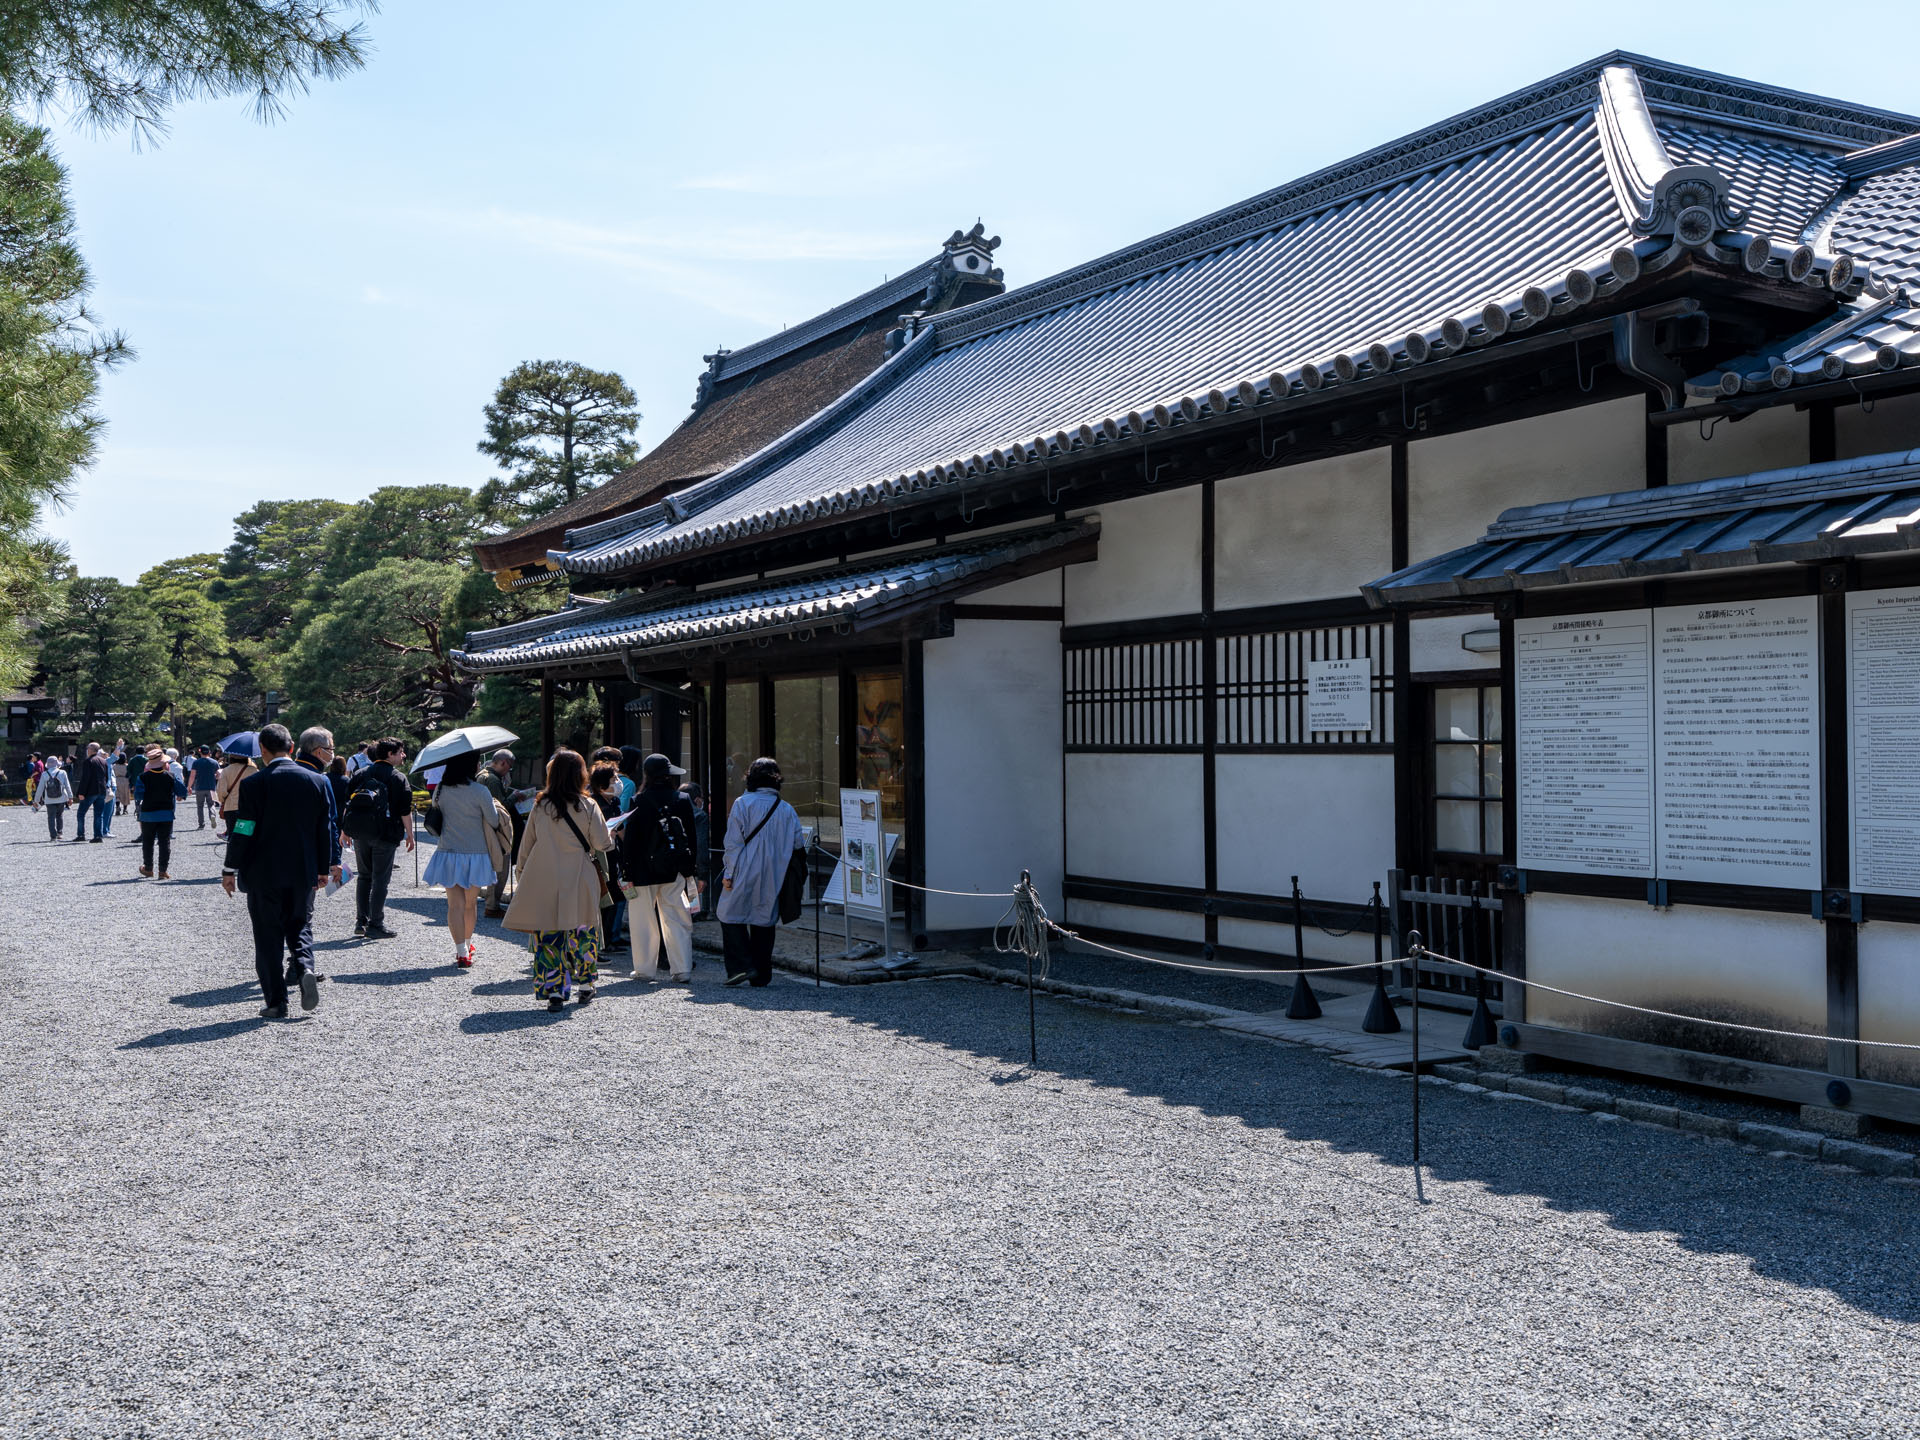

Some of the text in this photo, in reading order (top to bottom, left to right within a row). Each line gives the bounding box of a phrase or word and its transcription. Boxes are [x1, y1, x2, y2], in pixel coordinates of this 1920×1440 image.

[1877, 598, 1894, 606] Kyoto
[1697, 607, 1756, 620] 京都御所について
